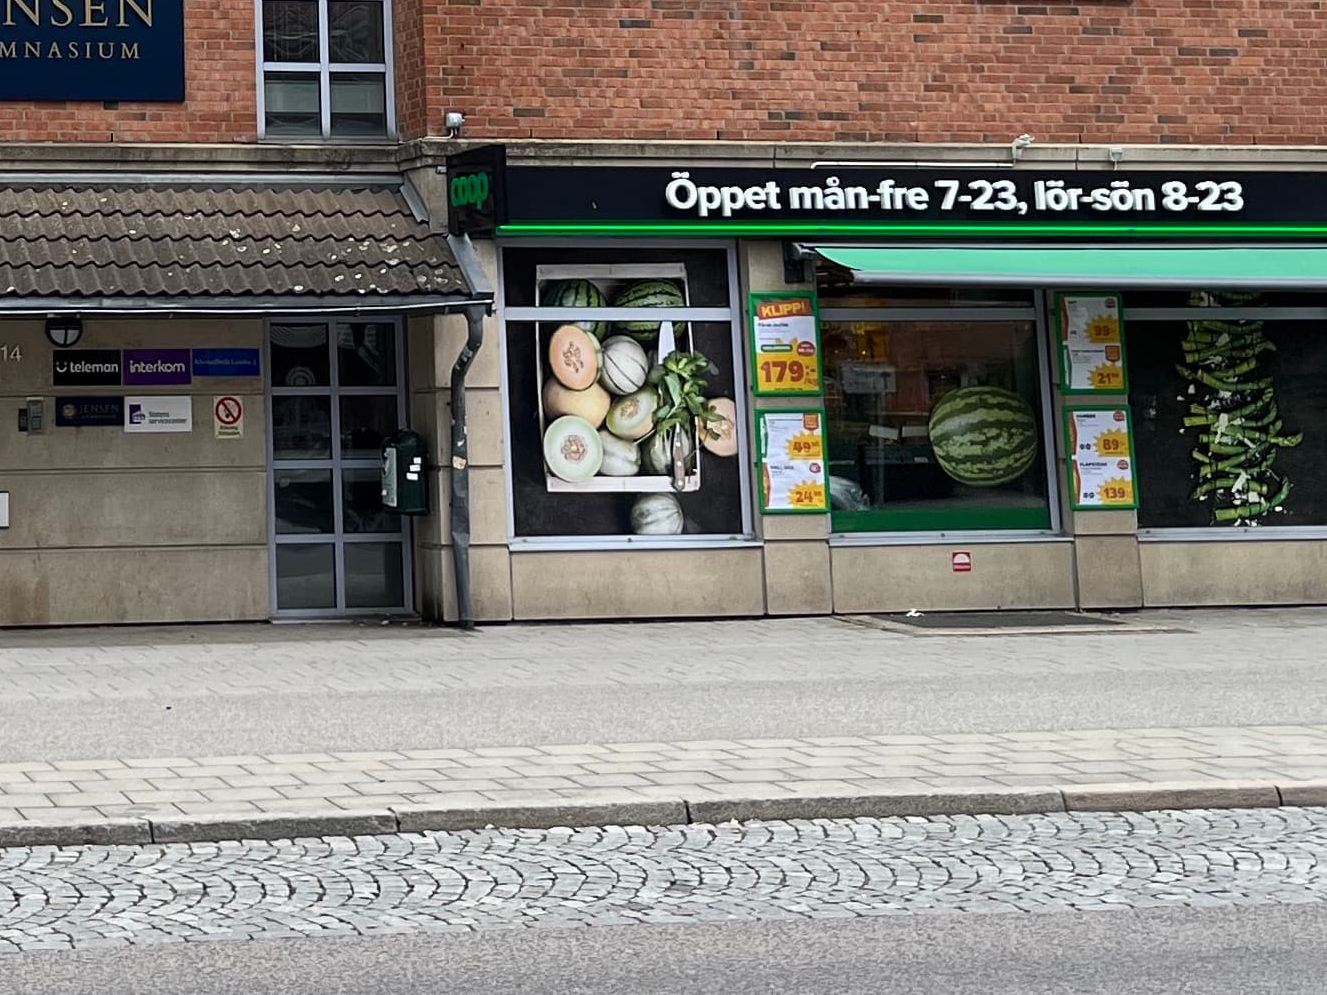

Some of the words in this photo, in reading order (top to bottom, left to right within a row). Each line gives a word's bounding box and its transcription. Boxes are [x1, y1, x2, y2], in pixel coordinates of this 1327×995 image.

[451, 172, 488, 210] coop
[665, 171, 782, 217] Öppet
[789, 176, 929, 210] mån-fre
[934, 179, 1028, 215] 7-23,
[1034, 180, 1156, 212] lör-sön
[1161, 180, 1244, 212] 8-23
[761, 301, 805, 318] KLIPP!
[0, 344, 22, 362] 14
[70, 361, 119, 374] teleman
[129, 360, 186, 374] interkom
[79, 404, 120, 413] JENSEN
